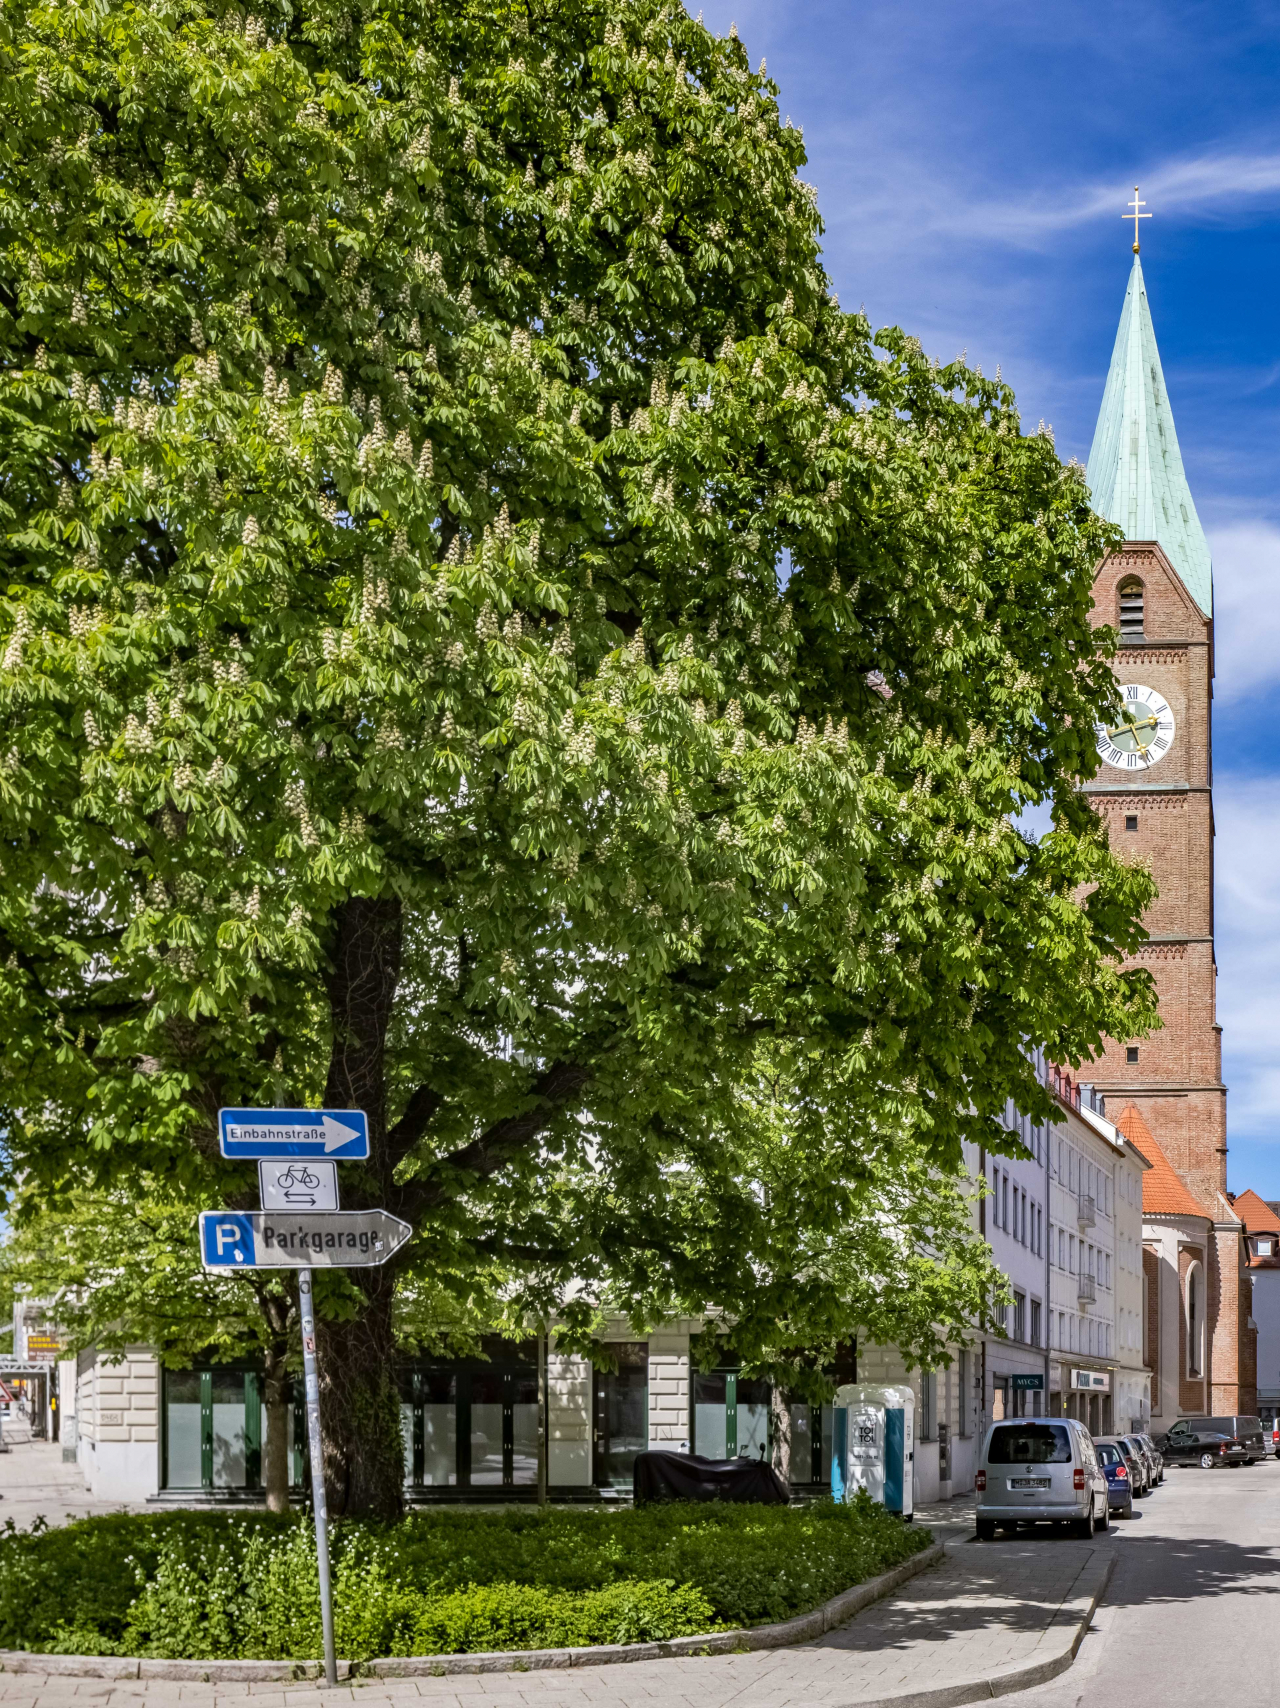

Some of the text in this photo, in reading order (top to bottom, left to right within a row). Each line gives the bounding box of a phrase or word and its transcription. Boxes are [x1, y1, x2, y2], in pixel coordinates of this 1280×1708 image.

[230, 1127, 327, 1140] Einbahnstraße
[215, 1224, 379, 1255] P Parkgarage
[1017, 1378, 1039, 1386] MYCS
